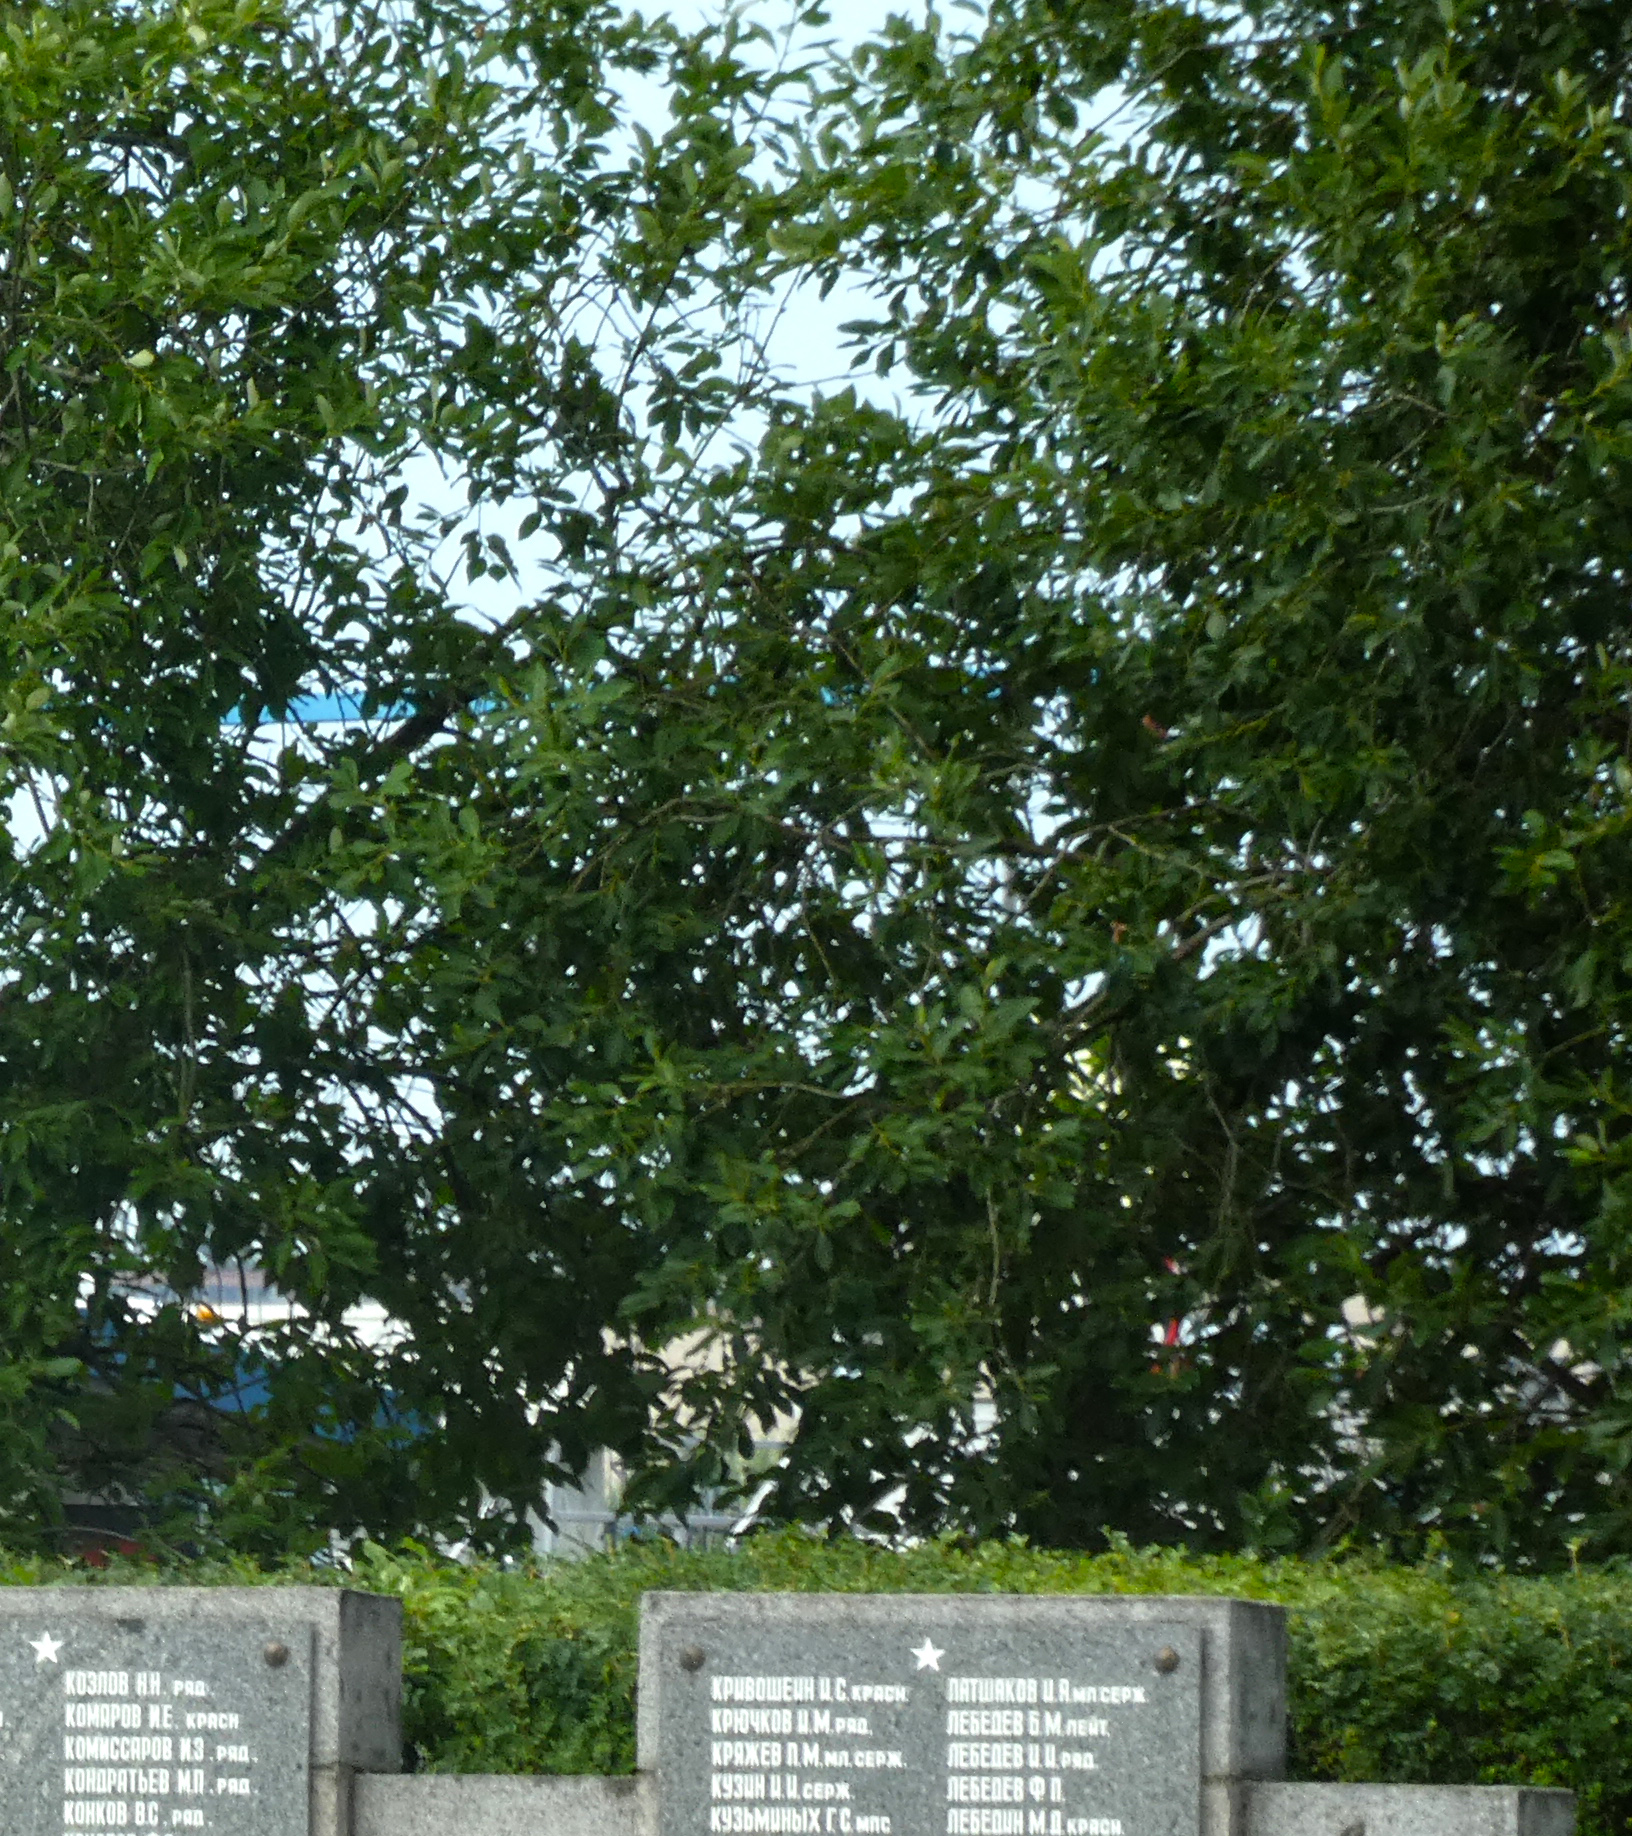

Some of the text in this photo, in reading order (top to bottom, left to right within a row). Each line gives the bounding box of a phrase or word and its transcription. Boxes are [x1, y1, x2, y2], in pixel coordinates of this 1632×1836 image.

[64, 1702, 142, 1728] КОМАРОВ
[710, 1707, 793, 1734] КРЮЧКОВ
[946, 1708, 1024, 1736] ЛЕБЕДЕВ
[63, 1735, 173, 1762] КОМИССАРОВ
[710, 1740, 782, 1766] КРЯЖЕВ
[63, 1767, 170, 1794] КОНДРАТЬЕВ
[710, 1772, 766, 1799] КУЗИН
[946, 1775, 1025, 1802] ЛЕБЕДЕВ
[63, 1800, 128, 1825] КОНКОВ
[709, 1805, 820, 1833] КУЗЬМИНЫХ
